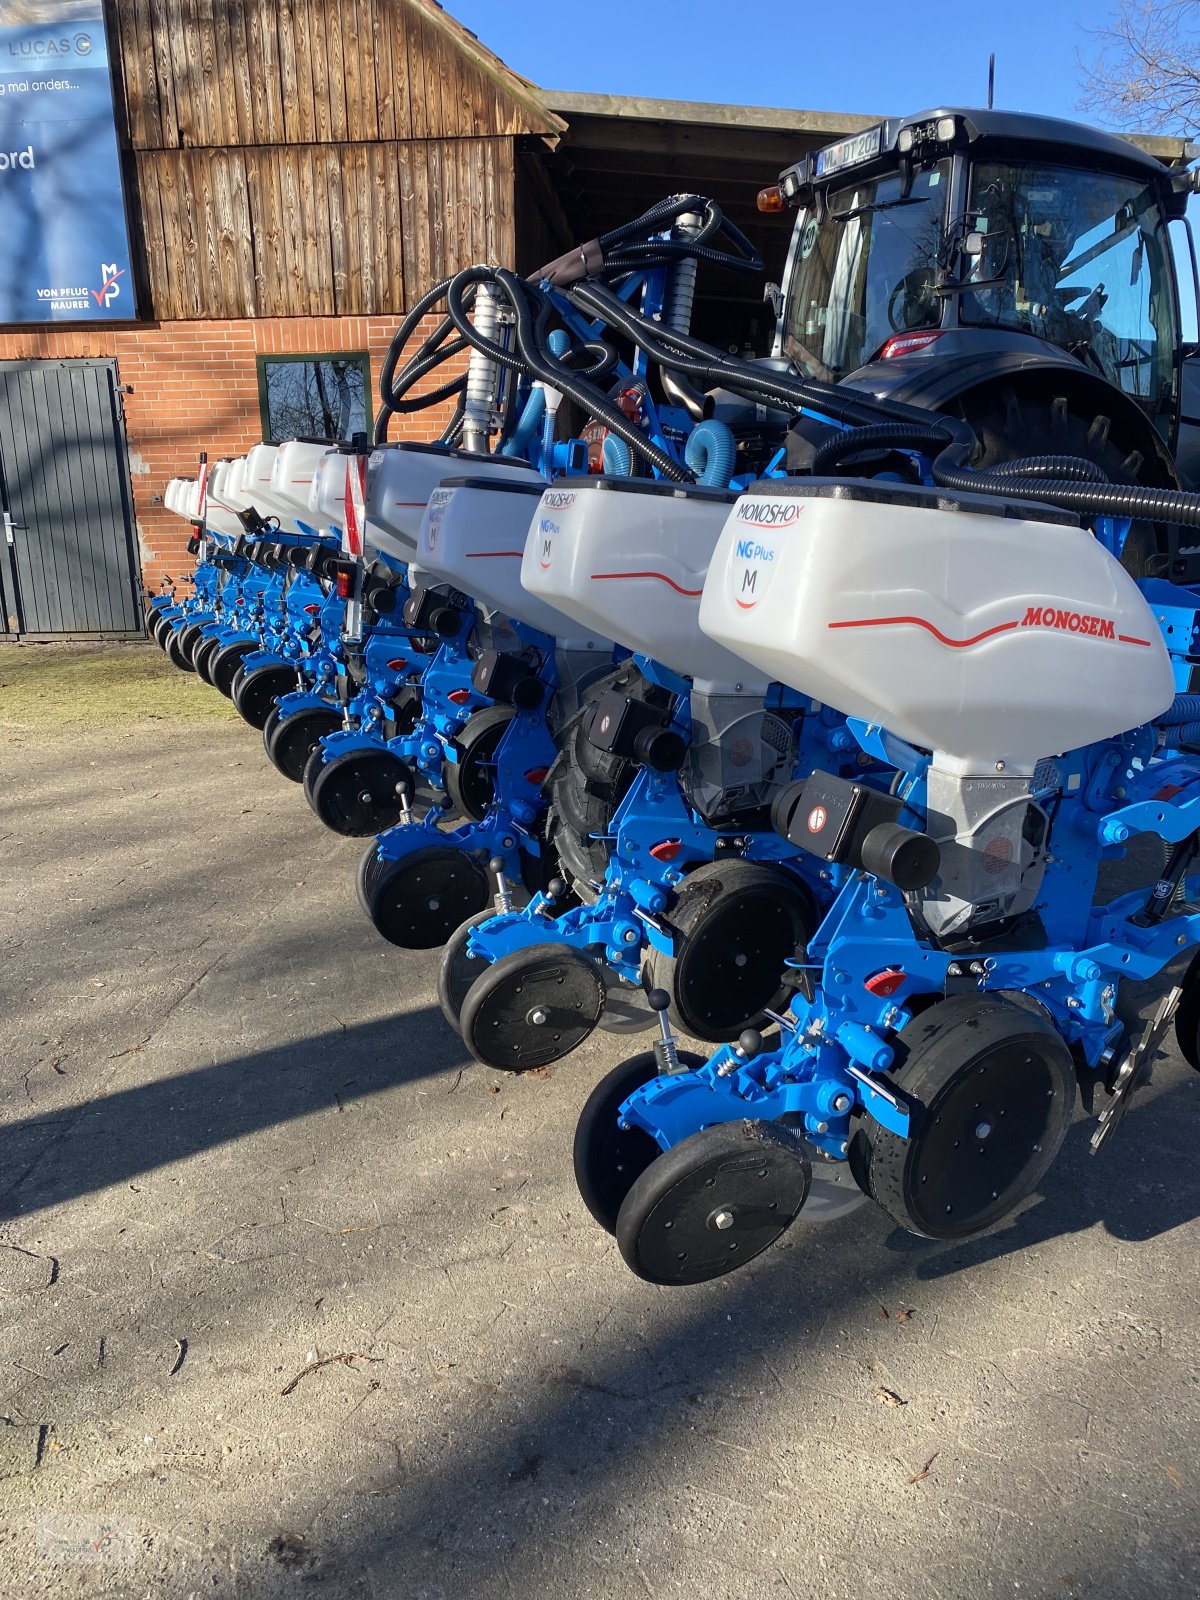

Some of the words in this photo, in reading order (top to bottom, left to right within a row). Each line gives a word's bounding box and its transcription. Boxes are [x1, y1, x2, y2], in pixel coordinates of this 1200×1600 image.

[8, 39, 71, 56] LUCAS
[8, 80, 29, 92] mal
[32, 79, 79, 91] anders...
[843, 140, 857, 162] DT
[858, 131, 878, 155] 201
[36, 288, 59, 298] VON
[60, 287, 88, 297] PFLUG
[50, 300, 90, 310] MAURER
[737, 503, 805, 524] MONOSHOX
[541, 519, 550, 533] NG
[542, 539, 552, 557] M
[736, 540, 755, 559] NG
[753, 545, 775, 562] Plus
[741, 568, 758, 594] M
[1020, 607, 1116, 640] MONOSEM
